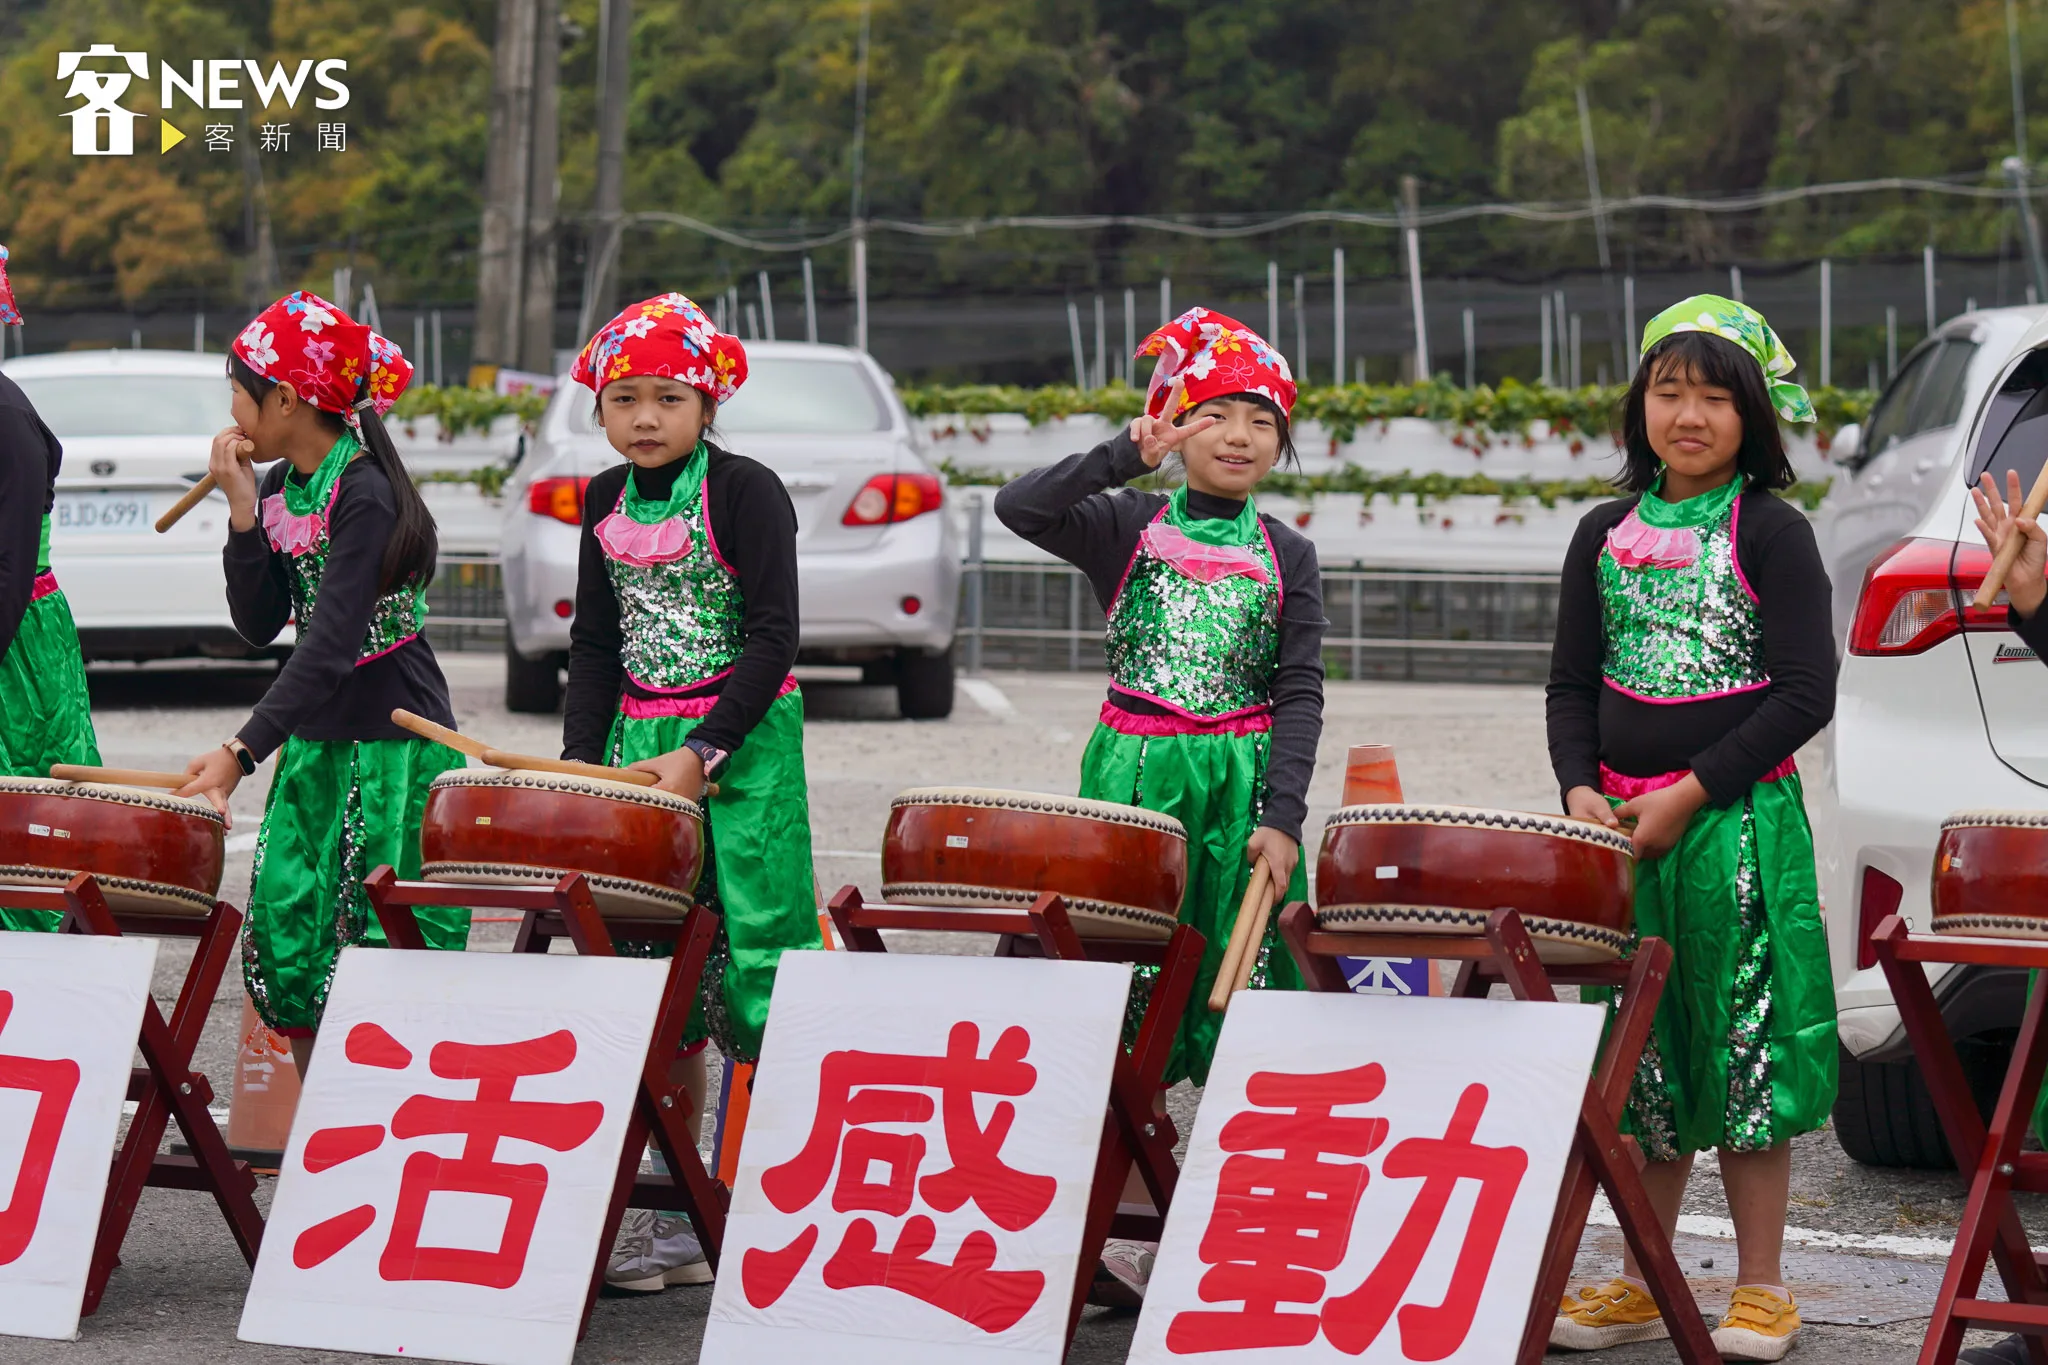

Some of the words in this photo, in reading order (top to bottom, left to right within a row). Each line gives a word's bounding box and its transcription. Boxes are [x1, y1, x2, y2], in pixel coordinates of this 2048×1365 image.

[293, 1022, 604, 1290] 活
[741, 1021, 1057, 1334] 感
[1166, 1062, 1529, 1362] 動
